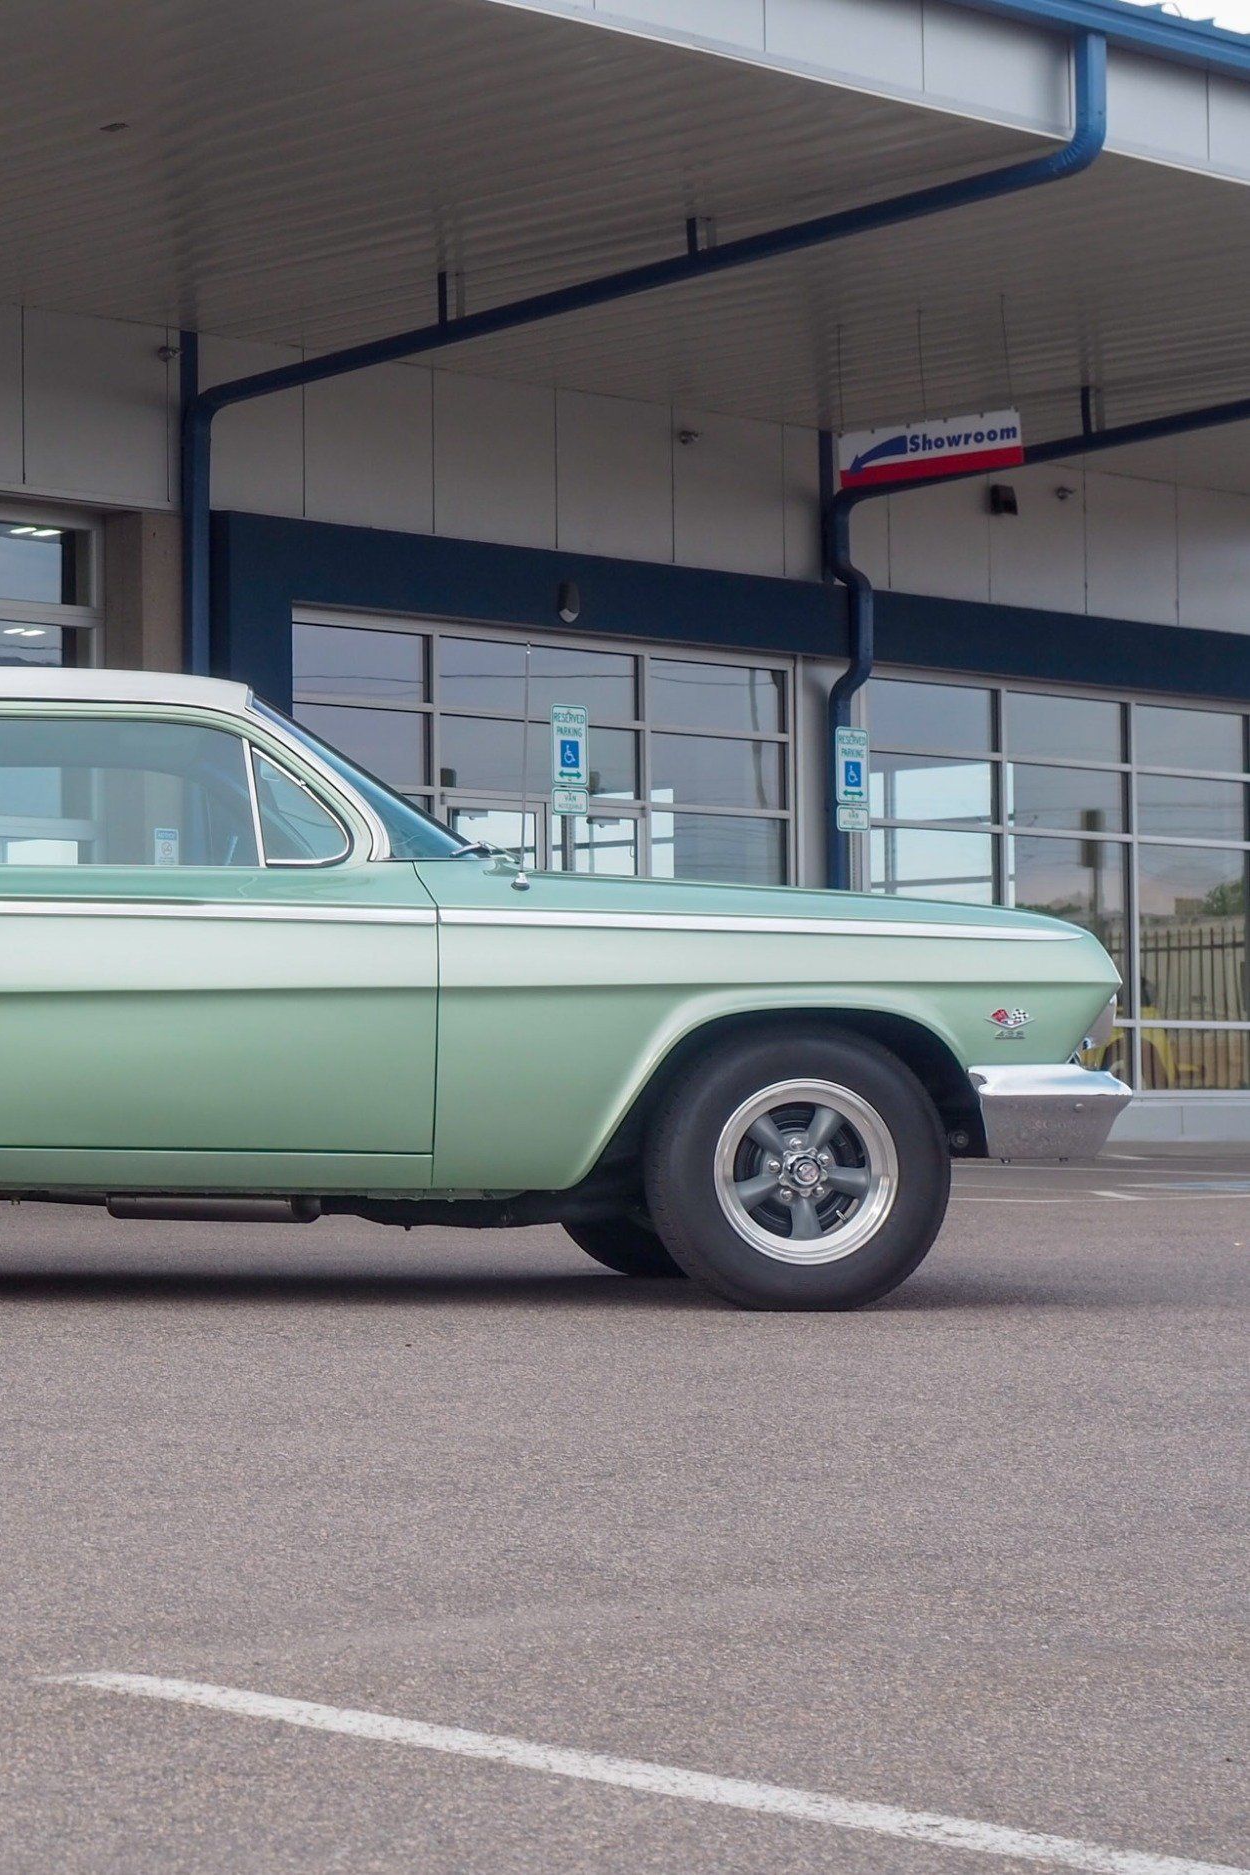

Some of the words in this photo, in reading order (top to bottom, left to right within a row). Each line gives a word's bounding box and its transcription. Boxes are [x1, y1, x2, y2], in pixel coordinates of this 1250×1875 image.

[908, 426, 1017, 453] Showroom
[553, 712, 585, 724] RESERVED
[556, 726, 583, 738] PARKING
[839, 736, 866, 746] RESERVED
